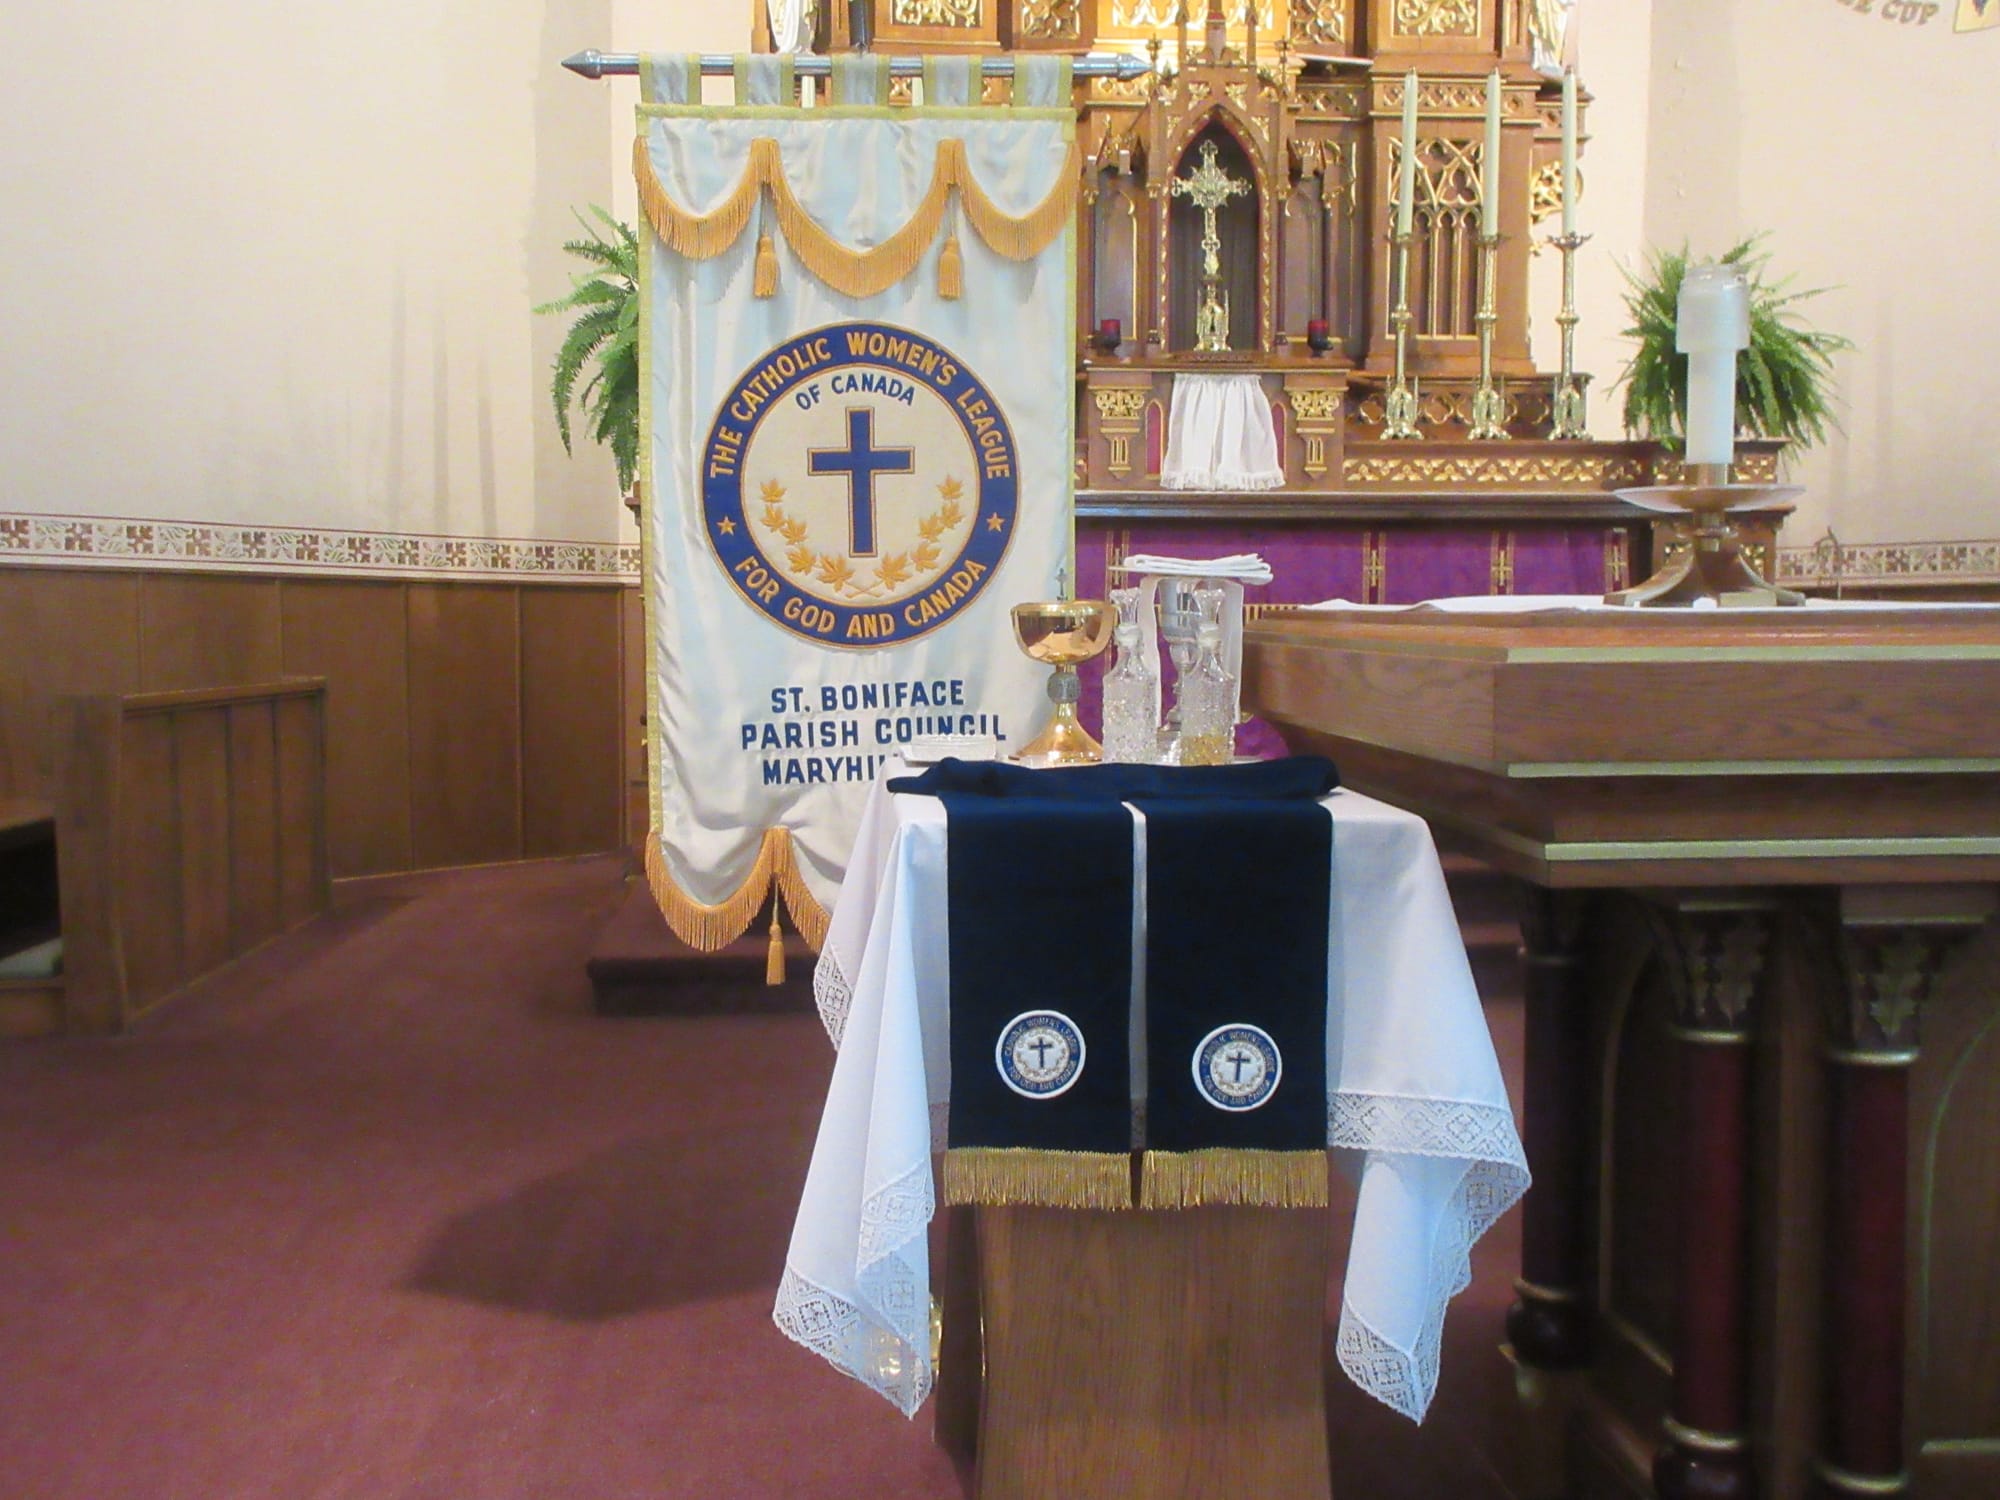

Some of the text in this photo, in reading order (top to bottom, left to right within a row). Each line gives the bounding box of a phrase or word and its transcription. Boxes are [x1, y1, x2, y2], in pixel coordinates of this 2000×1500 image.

[1880, 0, 1940, 25] CUP
[710, 331, 1010, 480] THE CATHOLIC WOMEN'S LEAGUE
[795, 373, 916, 411] OF CANADA
[734, 555, 987, 639] FOR GOD AND CANADA
[771, 679, 964, 713] ST. BONIFACE
[741, 714, 1006, 750] PARISH COUNCIL
